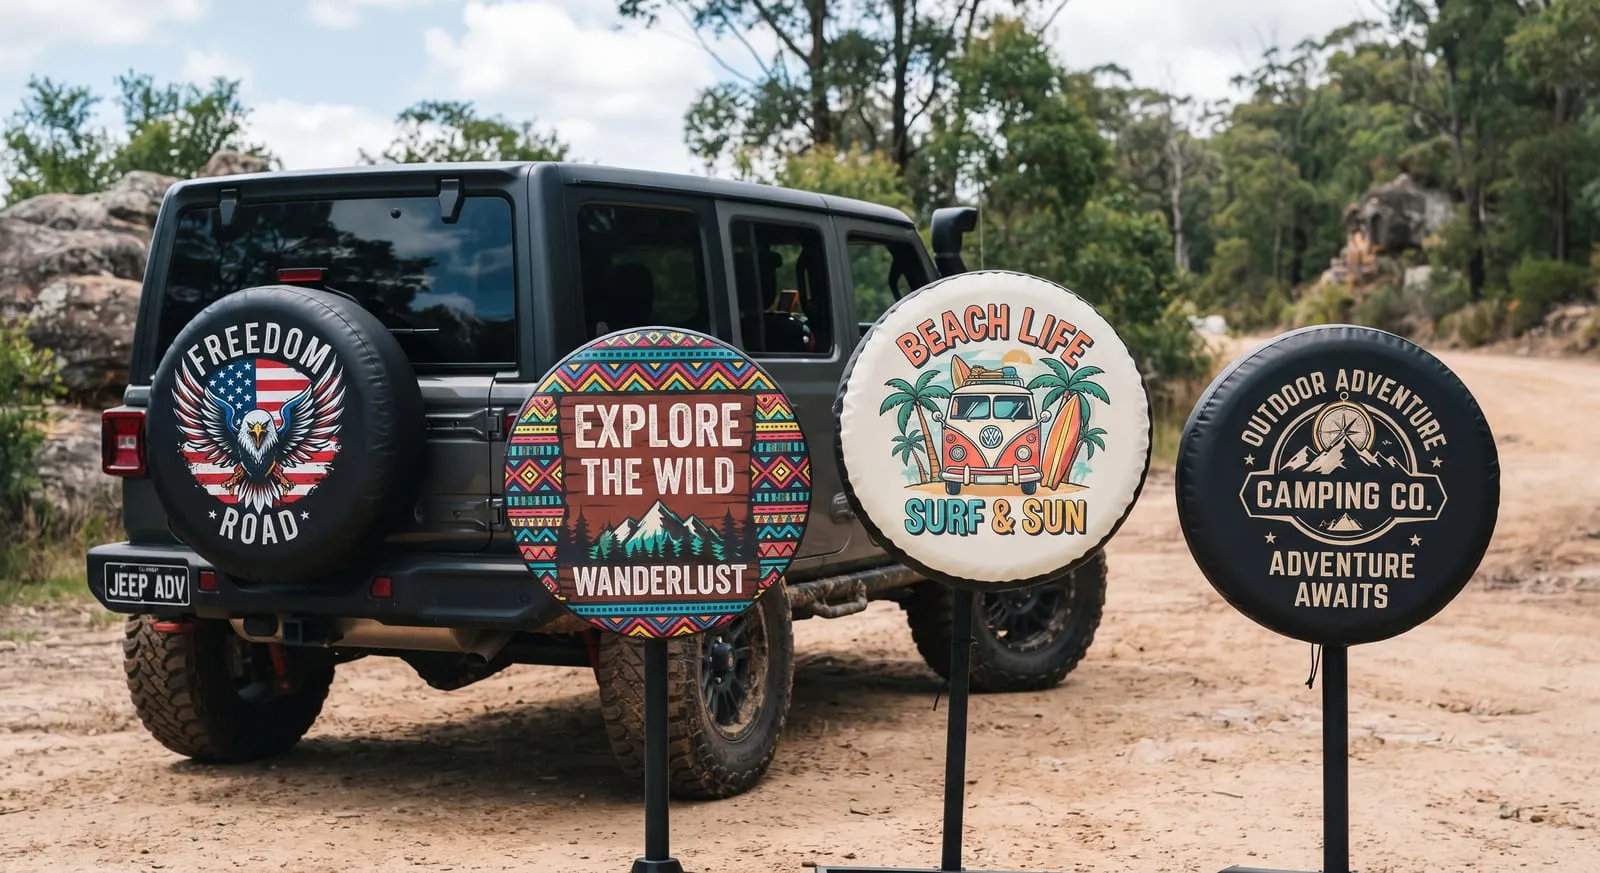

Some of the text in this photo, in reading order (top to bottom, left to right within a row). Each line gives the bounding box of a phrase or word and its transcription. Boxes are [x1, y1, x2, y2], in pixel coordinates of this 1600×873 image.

[187, 322, 331, 376] FREEDOM
[895, 304, 1095, 370] BEACH LIFE
[574, 403, 743, 448] EXPLORE
[1241, 368, 1448, 452] OUTDOOR ADVENTURE
[581, 457, 735, 496] THE WILD
[1256, 480, 1432, 511] CAMPING CO.
[219, 506, 299, 545] ROAD
[904, 498, 1088, 536] SURF & SUN
[573, 564, 747, 596] WANDERLUST
[1269, 551, 1416, 579] ADVENTURE
[109, 572, 186, 600] JEEP ADV
[1294, 582, 1388, 609] AWAITS
